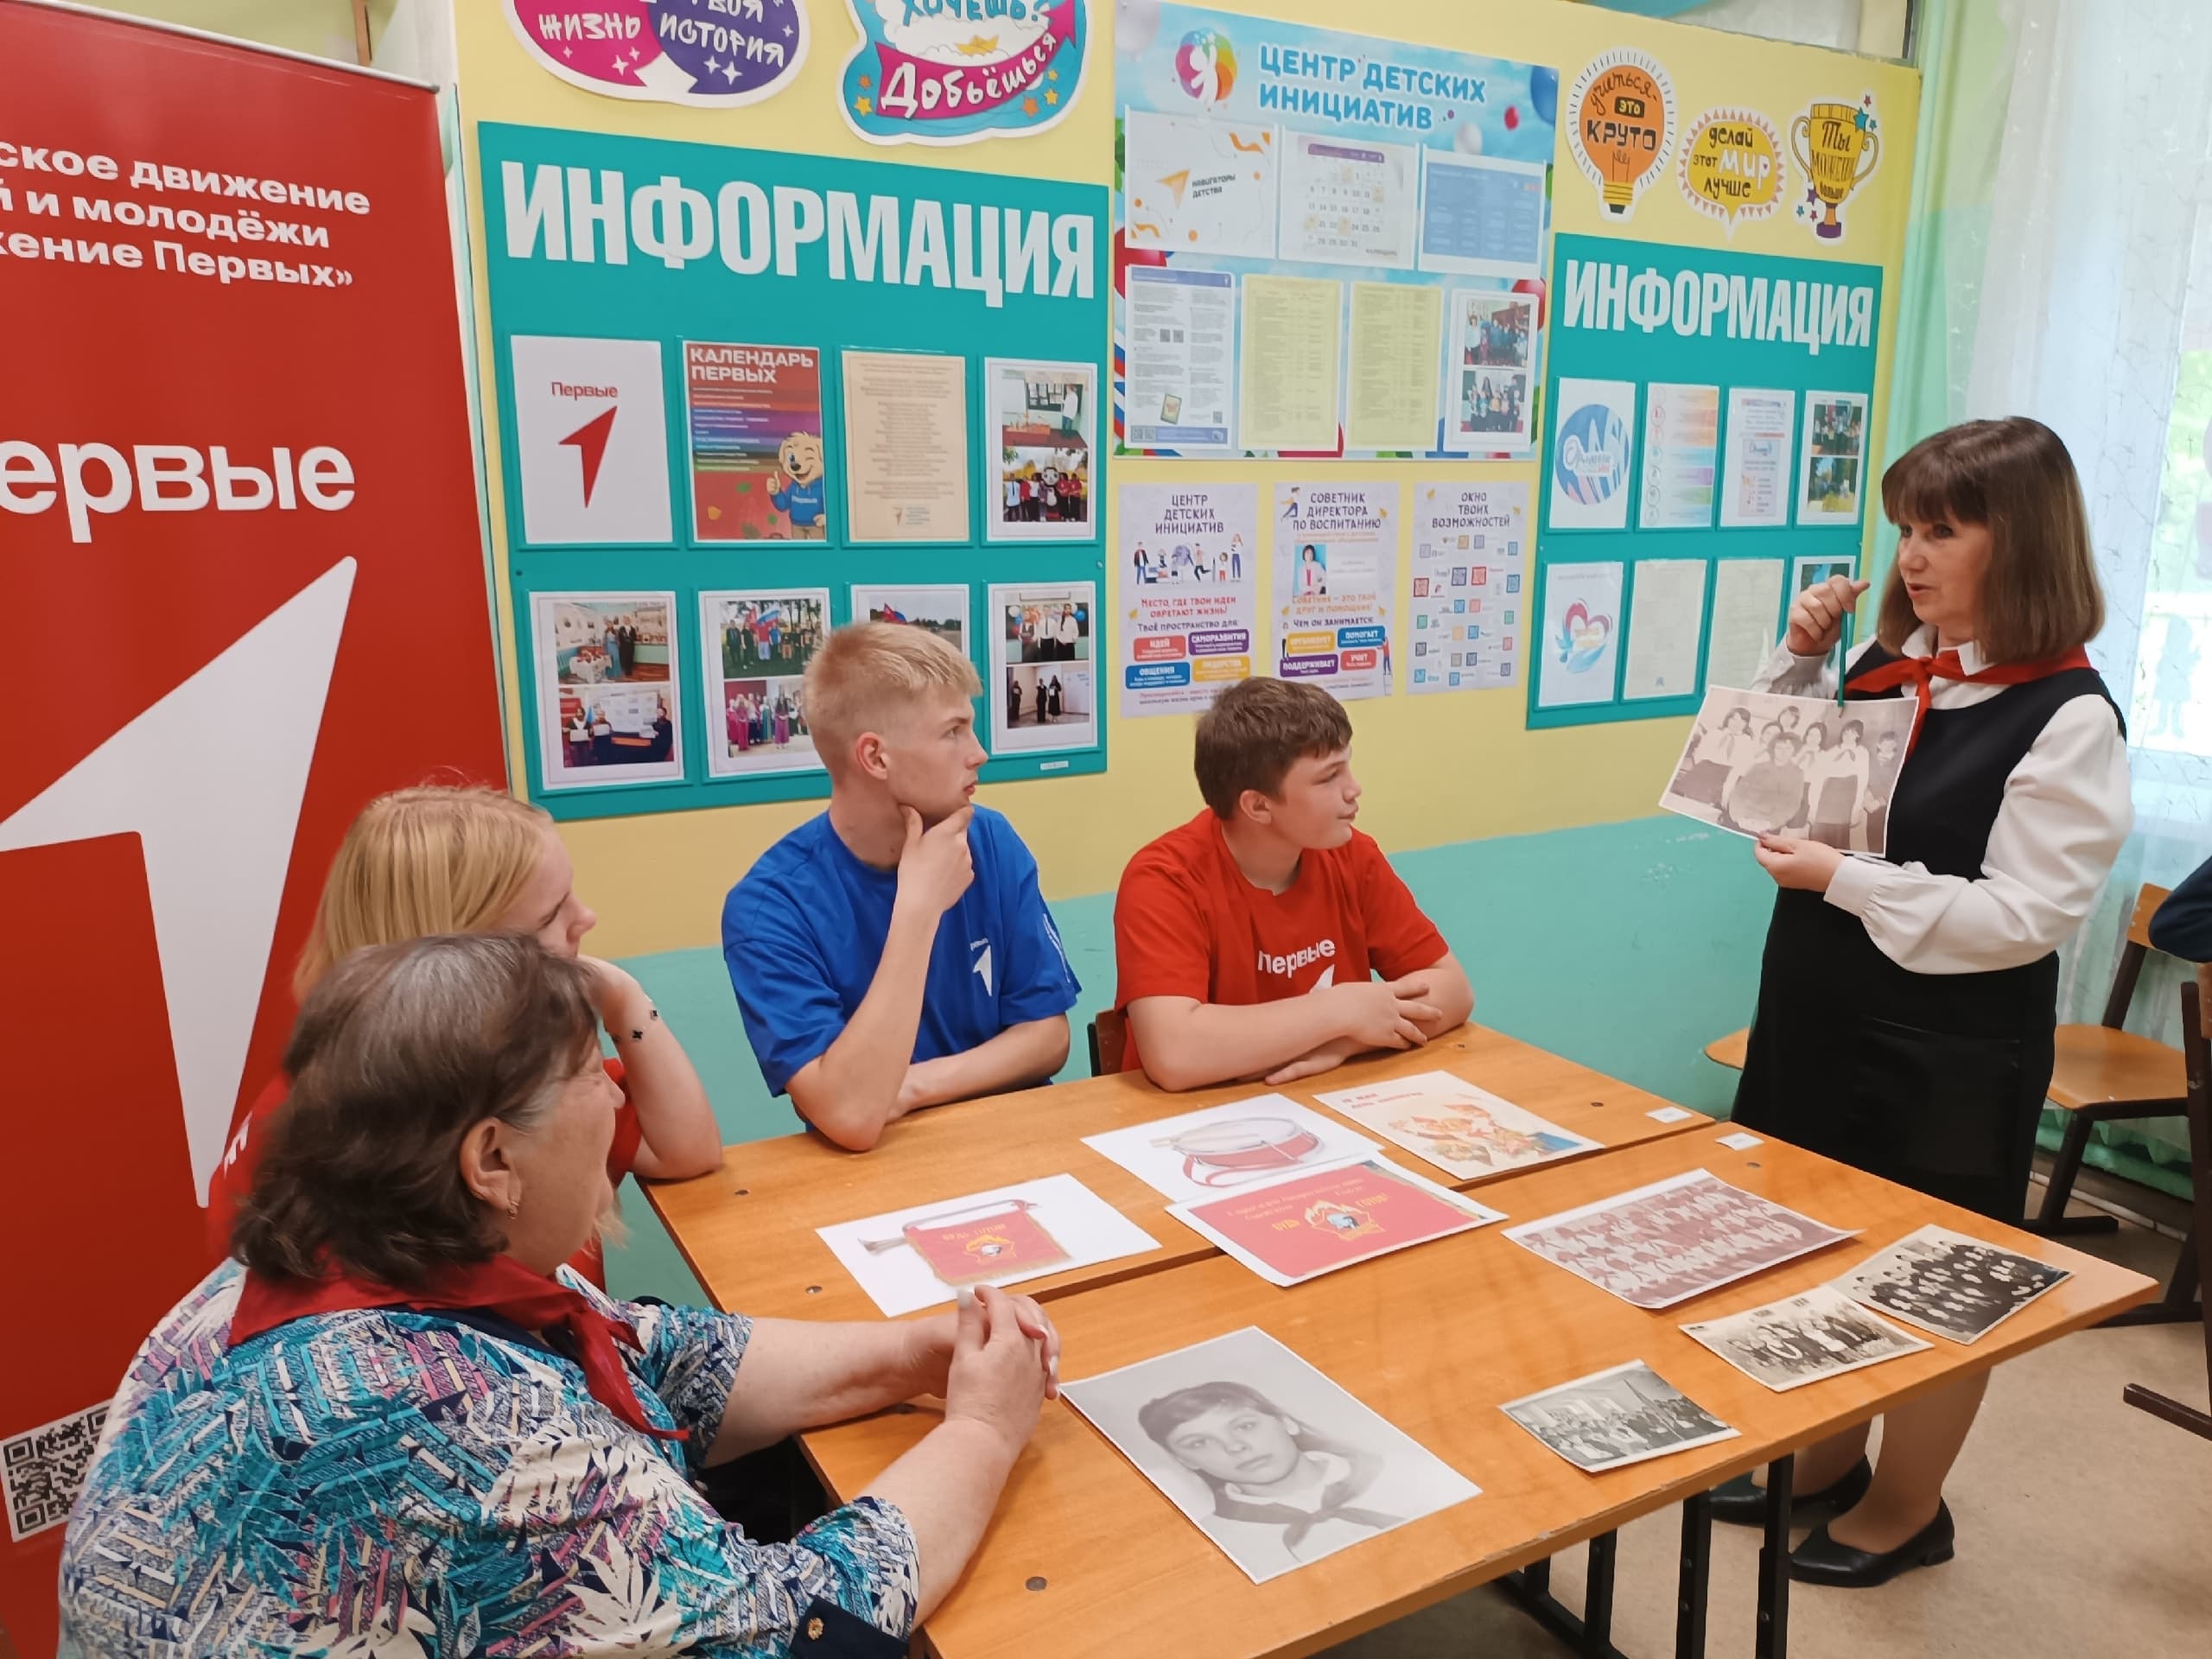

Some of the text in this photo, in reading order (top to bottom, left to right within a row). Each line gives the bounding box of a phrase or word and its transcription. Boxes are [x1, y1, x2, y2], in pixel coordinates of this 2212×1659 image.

[537, 12, 641, 41] ЖИЗНЬ
[659, 12, 784, 67] ИСТОРИЯ
[880, 33, 1057, 118] Добьёшься
[1260, 45, 1486, 103] ЦЕНТР ДЕТСКИХ
[1259, 83, 1433, 130] ИНИЦИАТИВ
[1586, 119, 1656, 151] КРУТО
[1709, 127, 1753, 149] делай
[1822, 120, 1851, 151] Ты
[130, 159, 371, 216] движение
[1703, 177, 1751, 200] лучше
[26, 190, 60, 217] и
[72, 195, 329, 249] молодёжи
[500, 159, 1095, 308] ИНФОРМАЦИЯ
[0, 231, 353, 288] ение Первых»
[1562, 258, 1874, 356] ИНФОРМАЦИЯ
[690, 348, 814, 368] КАЛЕНДАРЬ
[691, 365, 778, 384] ПЕРВЫХ
[551, 381, 619, 401] Первые
[0, 439, 355, 544] ервые
[1172, 493, 1208, 507] ЦЕНТР
[1310, 492, 1365, 504] СОВЕТНИК
[1461, 492, 1487, 503] ОКНО
[1164, 508, 1215, 522] ДЕТСКИХ
[1306, 505, 1368, 518] ДИРЕКТОРА
[1432, 514, 1510, 529] ВОЗМОЖНОСТЕЙ
[1458, 504, 1489, 515] ТВОИХ
[1155, 521, 1224, 535] ИНИЦИАТИВ
[1293, 518, 1382, 531] ПО ВОСПИТАНИЮ
[1257, 938, 1336, 979] Первые
